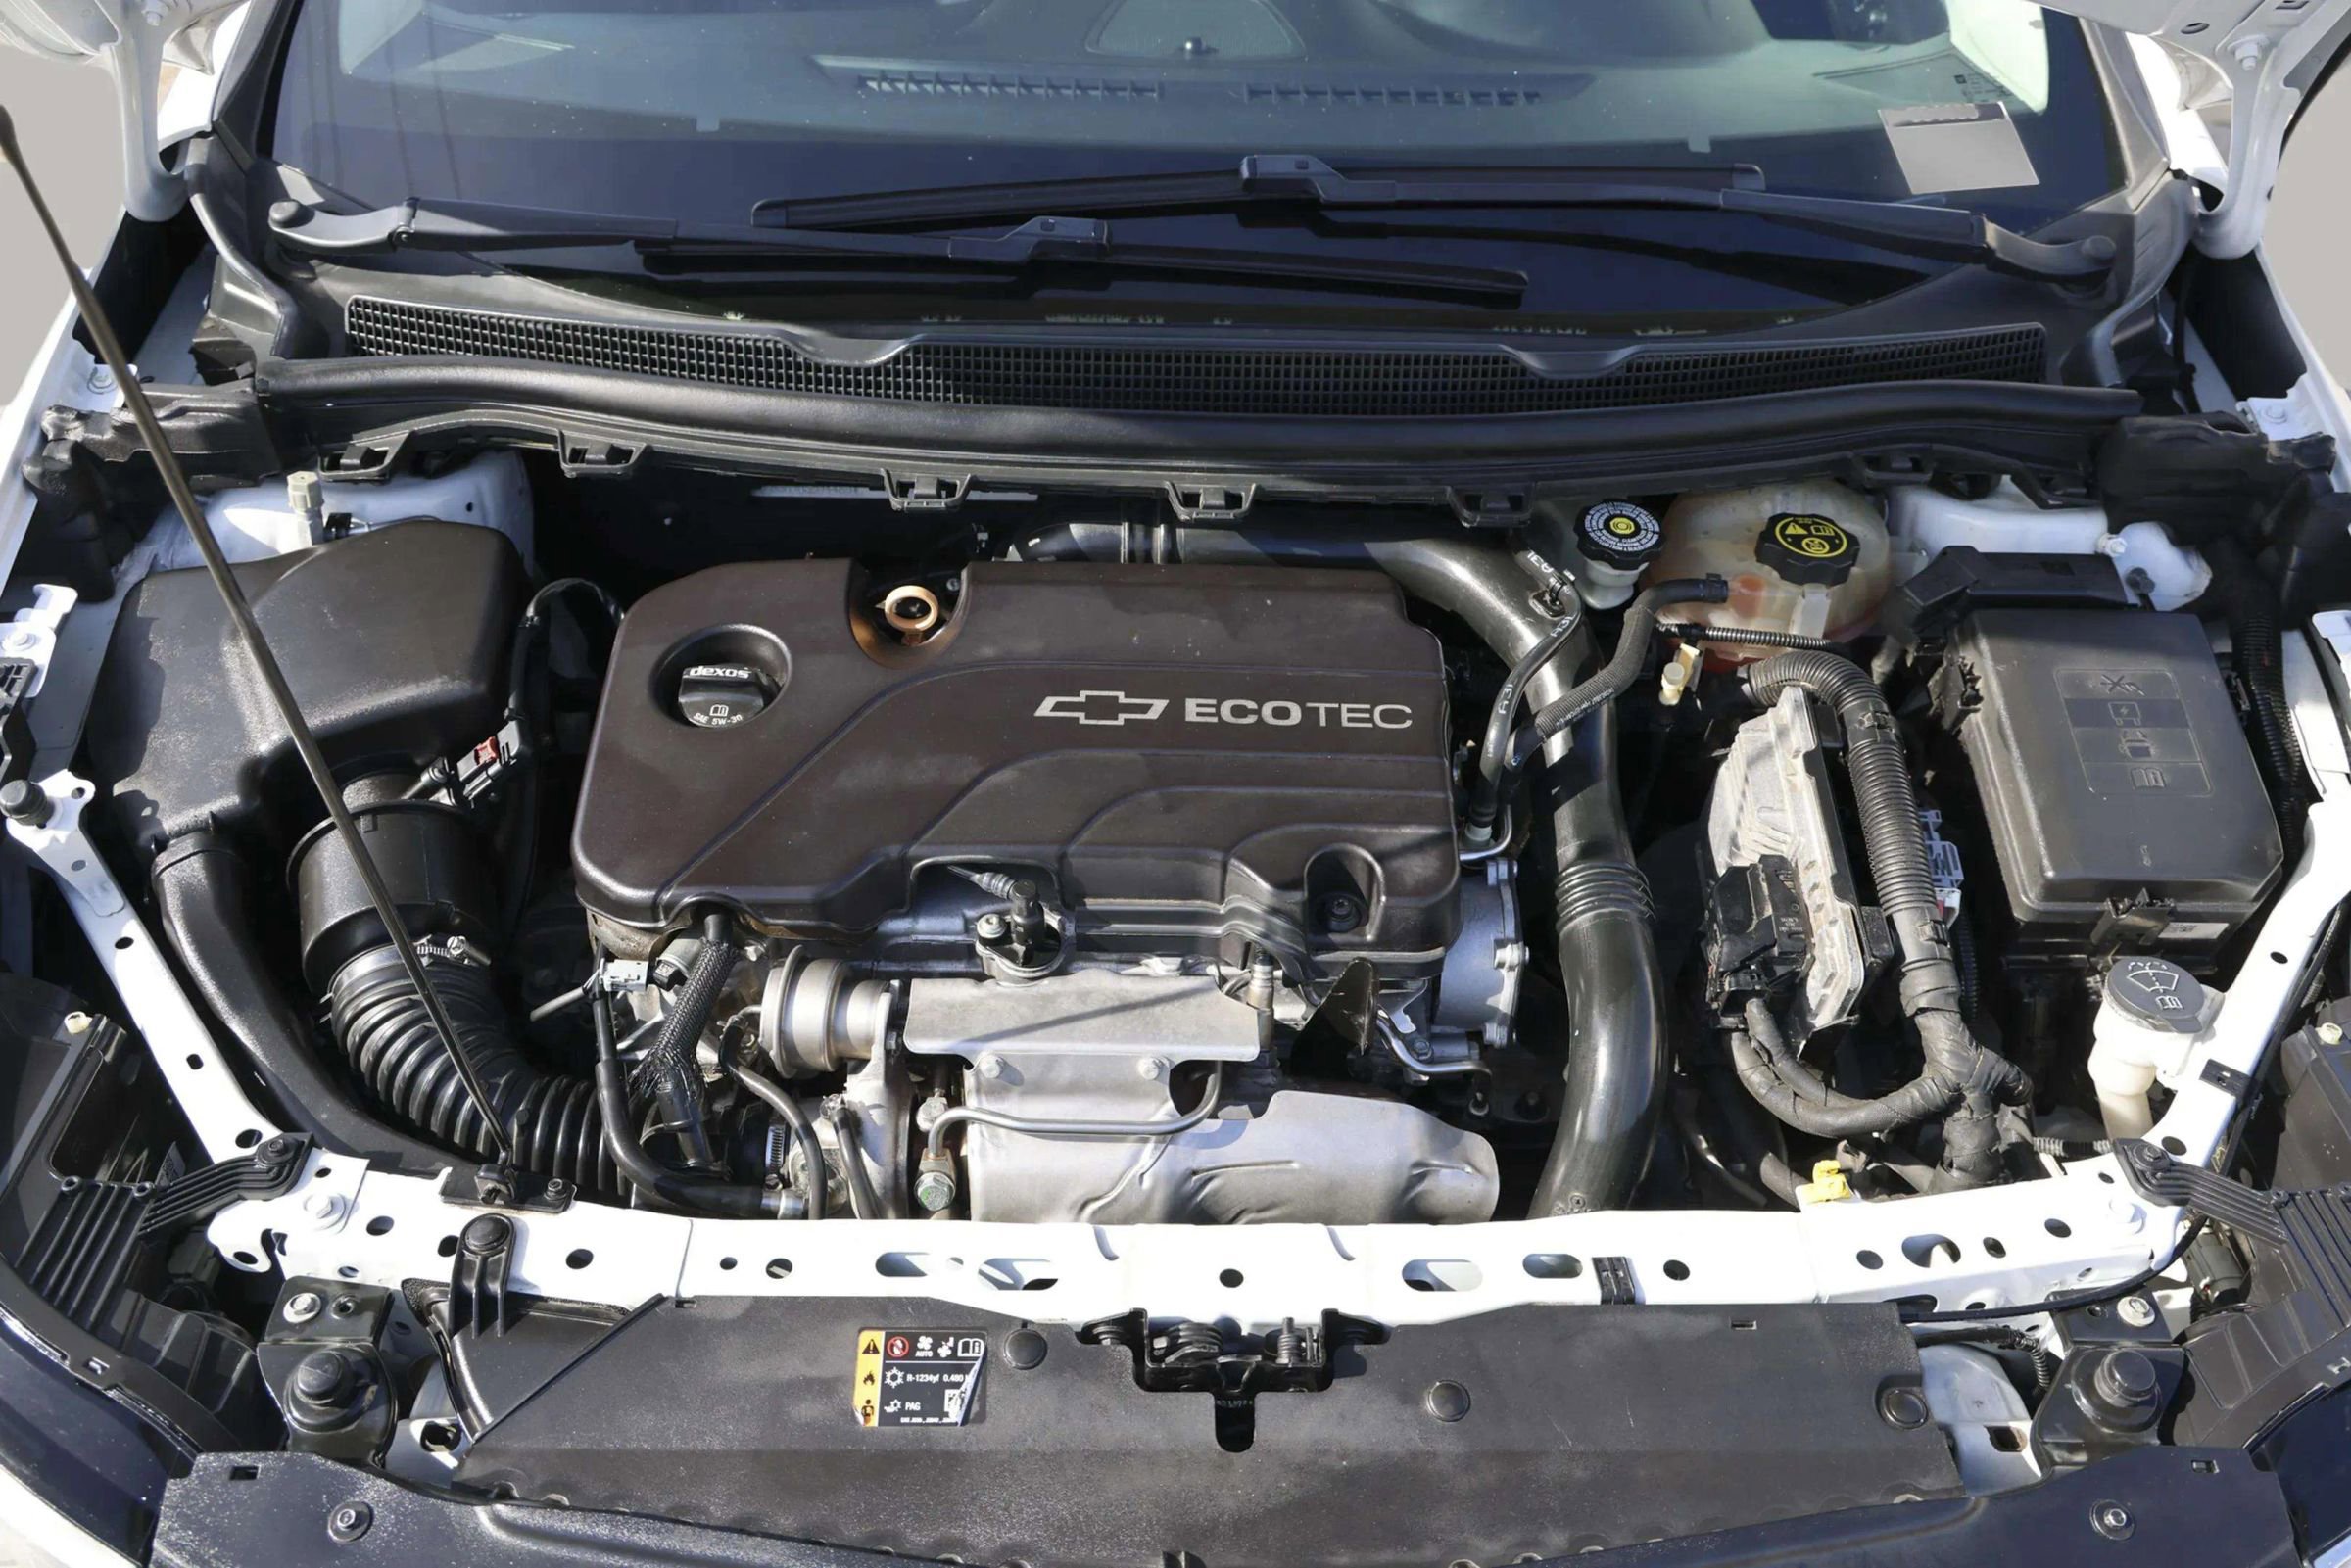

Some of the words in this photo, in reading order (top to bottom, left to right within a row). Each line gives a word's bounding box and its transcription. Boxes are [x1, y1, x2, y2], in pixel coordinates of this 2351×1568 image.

[690, 665, 750, 679] dexos
[693, 712, 710, 724] SAE
[1184, 697, 1413, 729] ECOTEC
